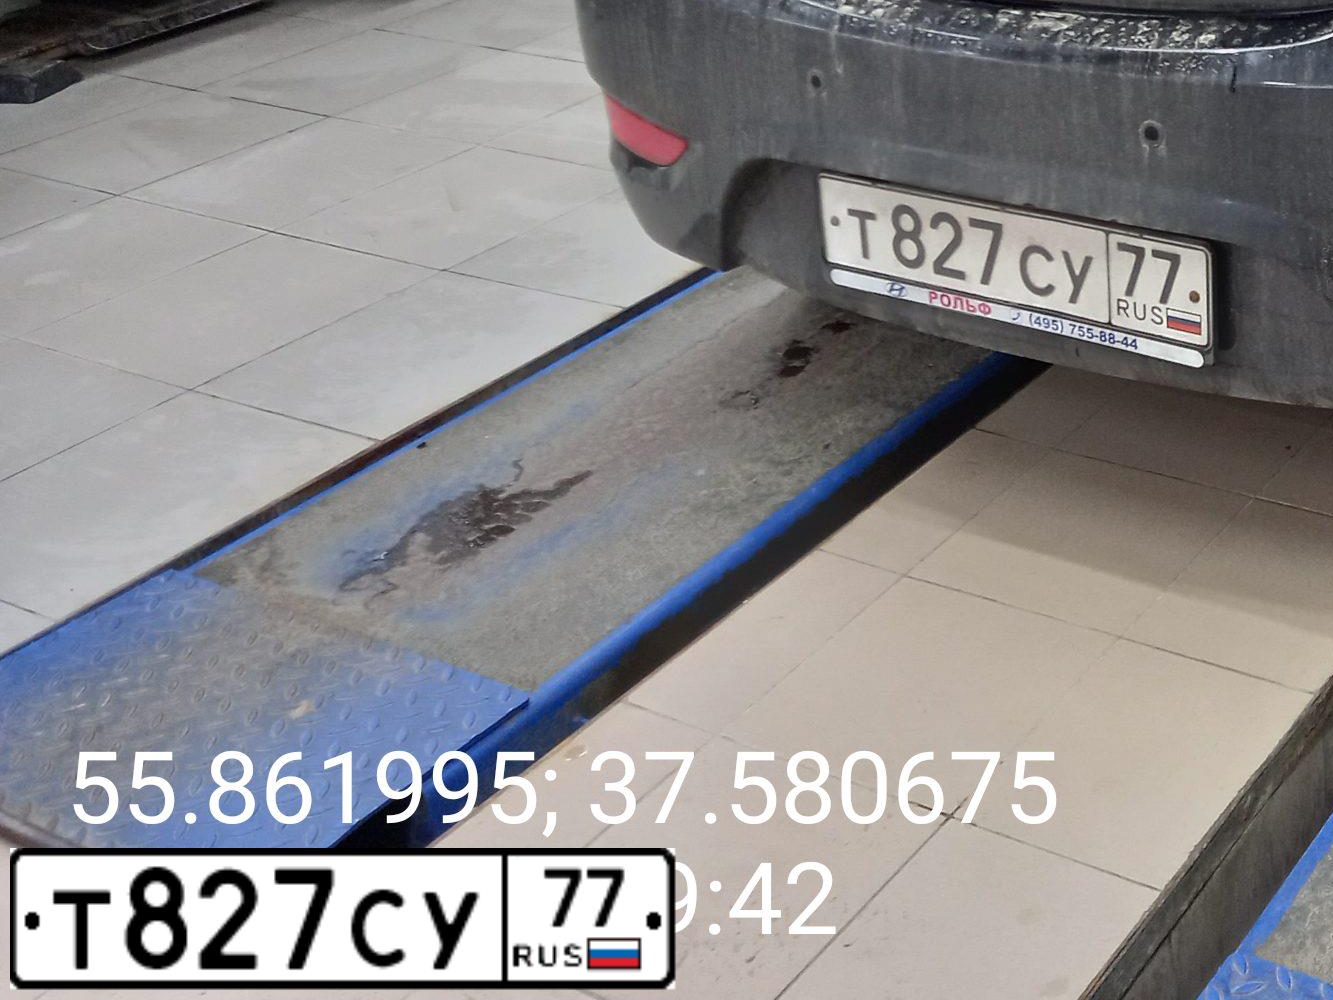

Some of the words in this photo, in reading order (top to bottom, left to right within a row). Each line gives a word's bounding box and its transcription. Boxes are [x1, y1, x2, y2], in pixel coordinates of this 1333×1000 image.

[1116, 242, 1182, 305] 77
[929, 291, 993, 317] РОЛЬФ
[1028, 312, 1065, 335] (495)
[1069, 324, 1139, 351] 755-88-44
[1116, 298, 1164, 325] RUS
